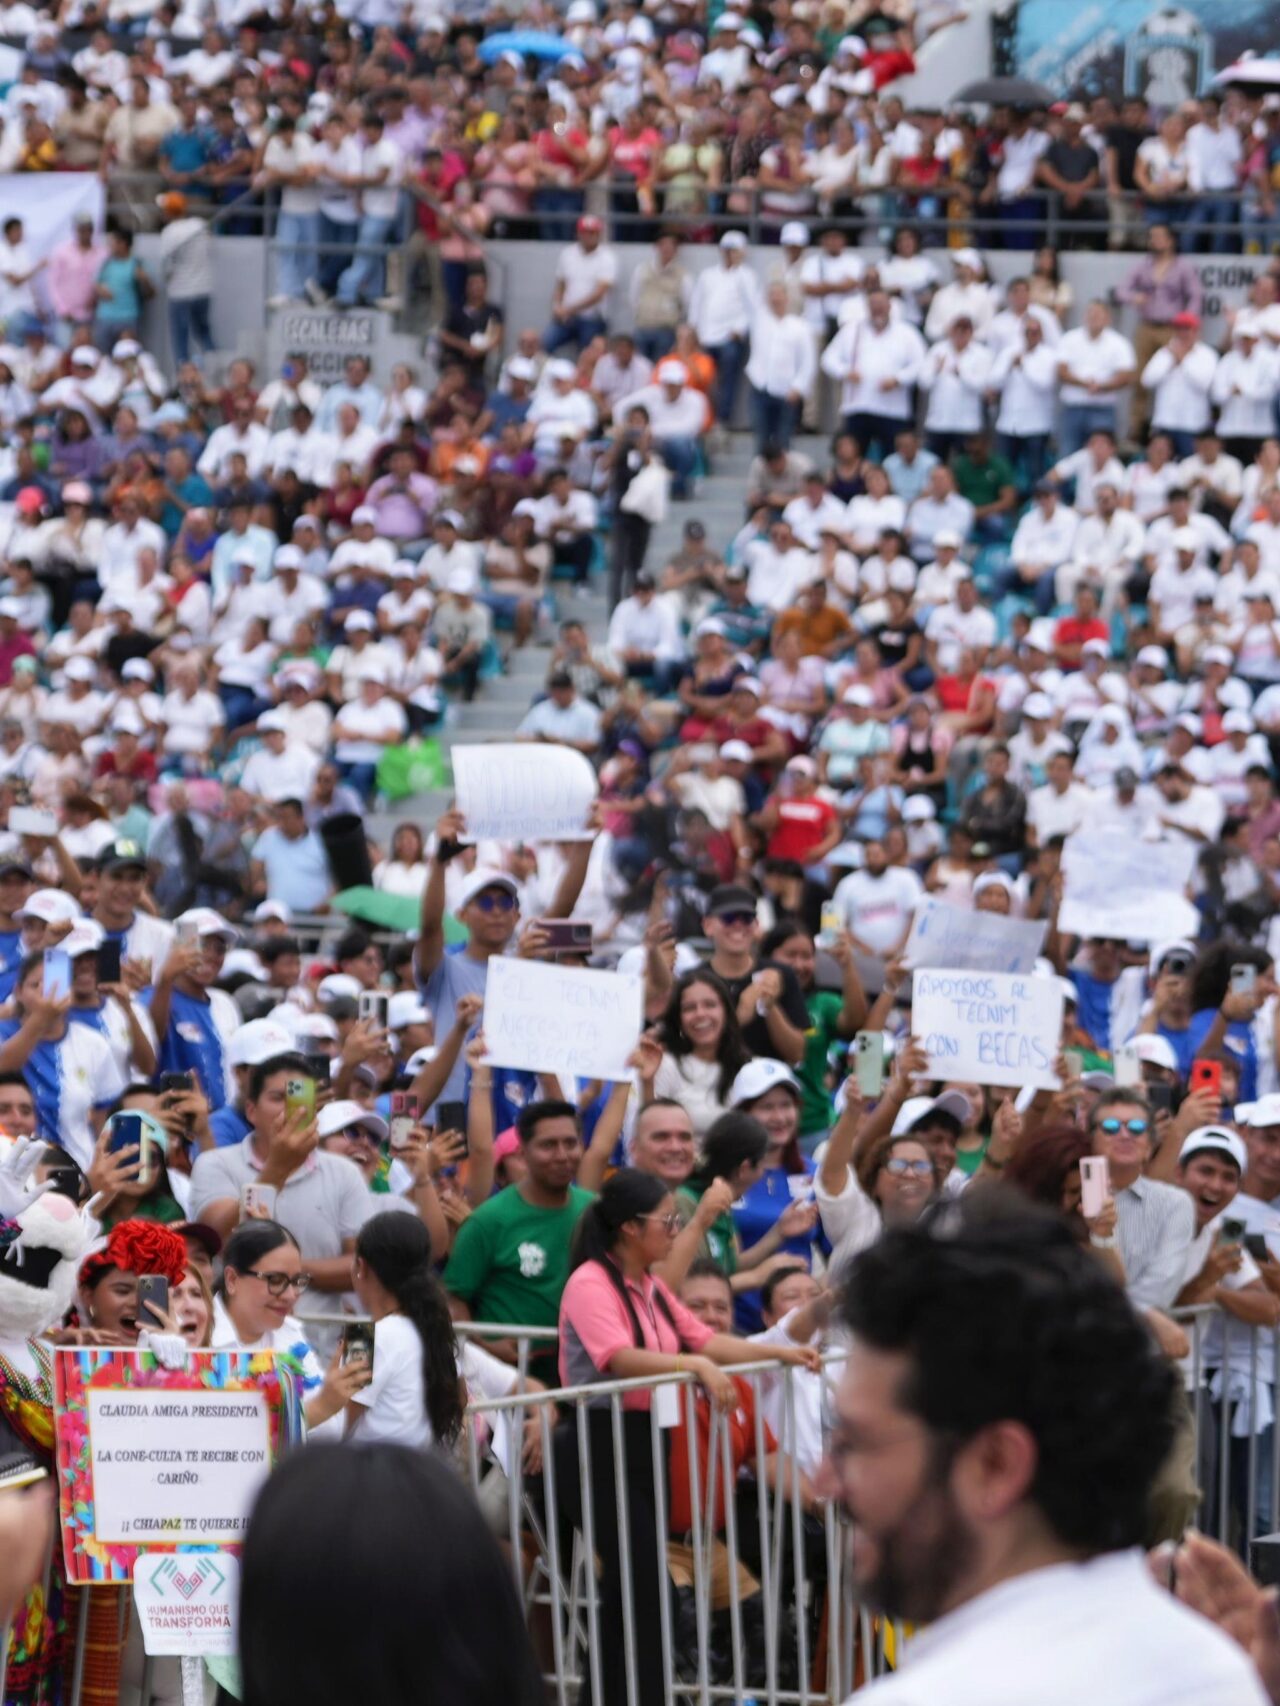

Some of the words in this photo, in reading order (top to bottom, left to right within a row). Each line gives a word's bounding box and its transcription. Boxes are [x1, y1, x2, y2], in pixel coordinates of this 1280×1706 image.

[1201, 264, 1254, 289] CION
[951, 999, 1016, 1025] TECNM
[925, 1033, 959, 1058] CON
[977, 1032, 1049, 1070] BECAS
[99, 1404, 149, 1418] CLAUDIA
[152, 1404, 189, 1418] AMIGA
[191, 1404, 259, 1418] PRESIDENTA
[97, 1450, 112, 1462] LA
[114, 1450, 183, 1463] CONE-CULTA
[186, 1450, 198, 1462] TE
[201, 1450, 238, 1462] RECIBE
[241, 1450, 265, 1462] CON
[157, 1470, 199, 1485] CARIÑO
[133, 1518, 181, 1530] CHIAPAZ
[184, 1518, 198, 1530] TE
[200, 1518, 240, 1532] QUIERE
[147, 1605, 206, 1616] HUMANISMO
[208, 1604, 229, 1616] QUE
[148, 1616, 231, 1628] TRANSFORMA
